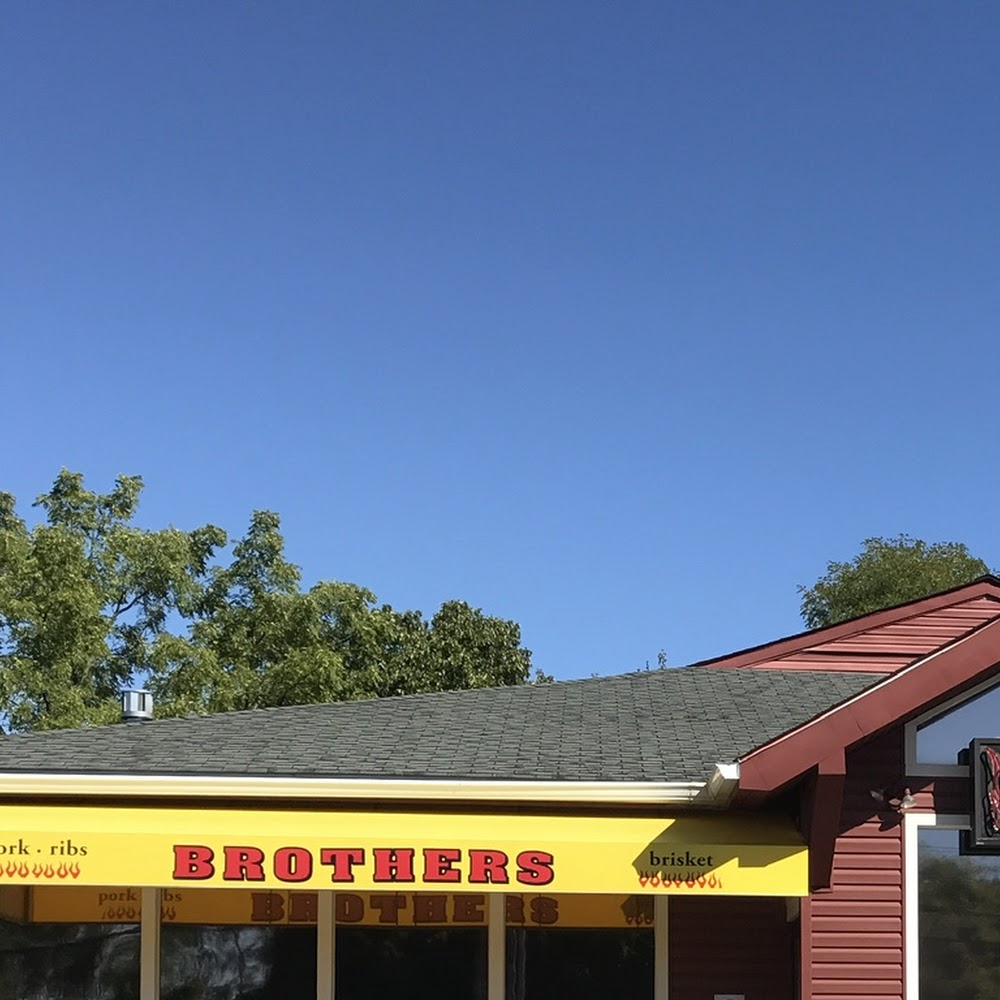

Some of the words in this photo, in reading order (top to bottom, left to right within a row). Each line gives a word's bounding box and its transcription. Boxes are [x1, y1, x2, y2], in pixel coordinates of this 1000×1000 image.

[50, 839, 88, 856] ribs
[172, 845, 554, 885] BROTHERS
[650, 851, 713, 866] brisket
